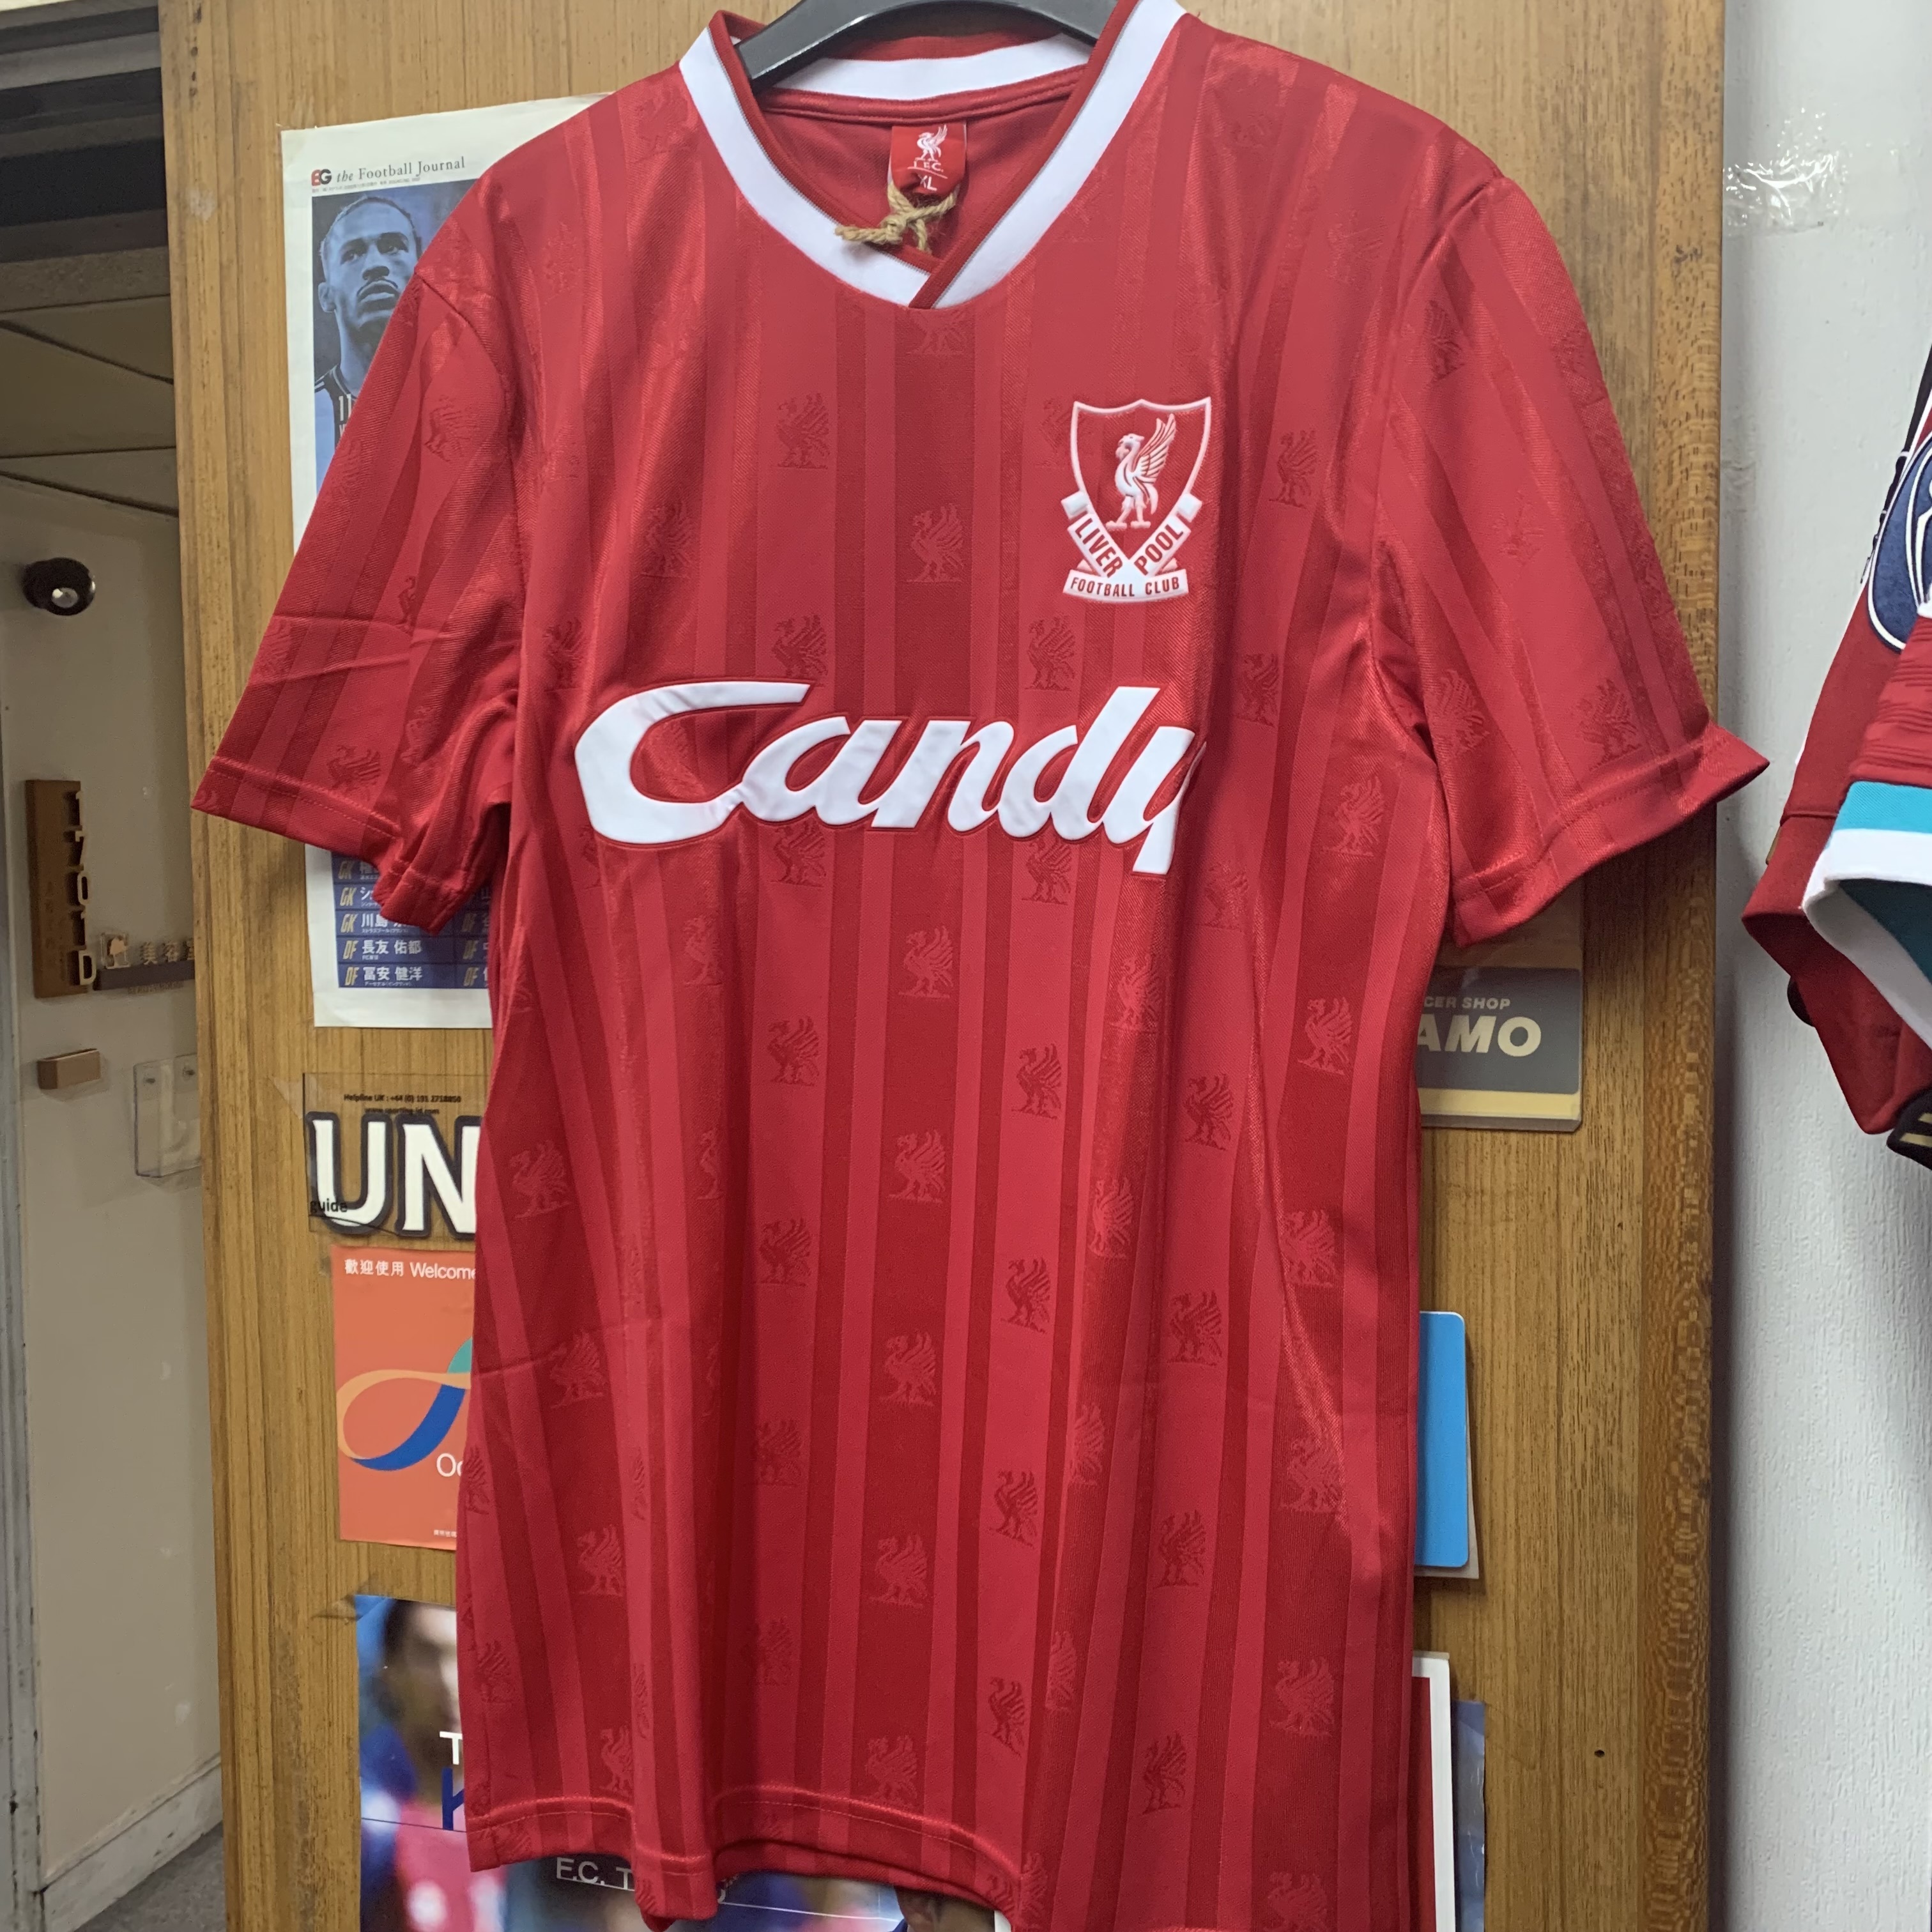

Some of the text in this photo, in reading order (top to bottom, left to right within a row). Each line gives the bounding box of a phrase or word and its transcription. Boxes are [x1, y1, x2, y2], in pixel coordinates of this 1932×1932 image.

[337, 170, 353, 183] the
[358, 162, 412, 180] Football
[415, 156, 465, 177] Journal
[918, 175, 937, 191] XL
[1075, 518, 1184, 578] LIVER POOL
[1070, 576, 1180, 597] FOOTBALL CLUB
[574, 680, 1205, 875] Candy
[340, 887, 356, 906] GK
[360, 887, 374, 901] シ
[341, 914, 358, 933] GK
[342, 940, 359, 960] DF
[362, 940, 422, 954] 長友 佑都
[345, 966, 360, 986] DF
[394, 966, 422, 981] 健洋
[1462, 997, 1511, 1010] SHOP
[310, 1198, 348, 1213] guide
[344, 1259, 404, 1277] 歡迎使用
[556, 1857, 605, 1885] F.C.
